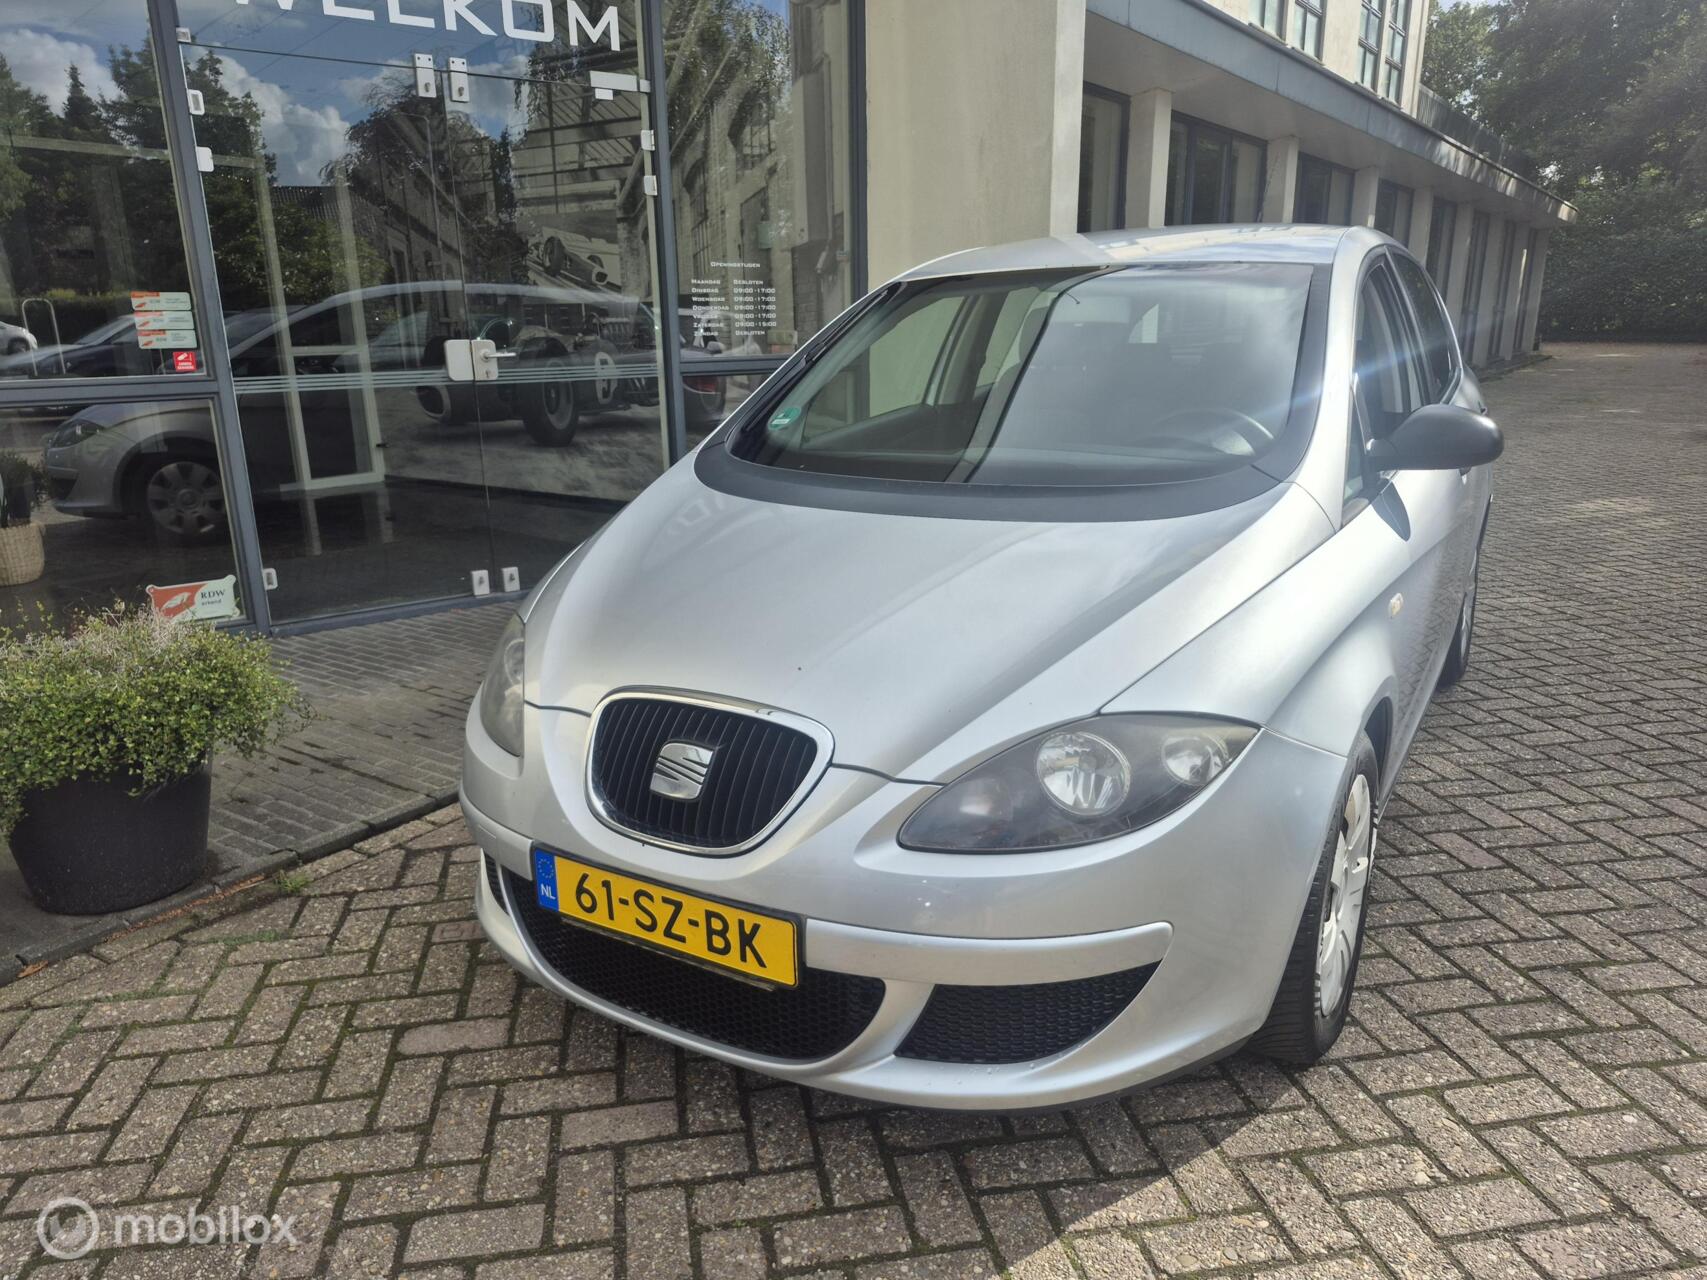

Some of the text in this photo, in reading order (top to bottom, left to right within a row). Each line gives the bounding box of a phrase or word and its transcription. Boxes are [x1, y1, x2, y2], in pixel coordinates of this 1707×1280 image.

[201, 589, 225, 598] RDW
[540, 872, 767, 969] NL 61-SZ-BK
